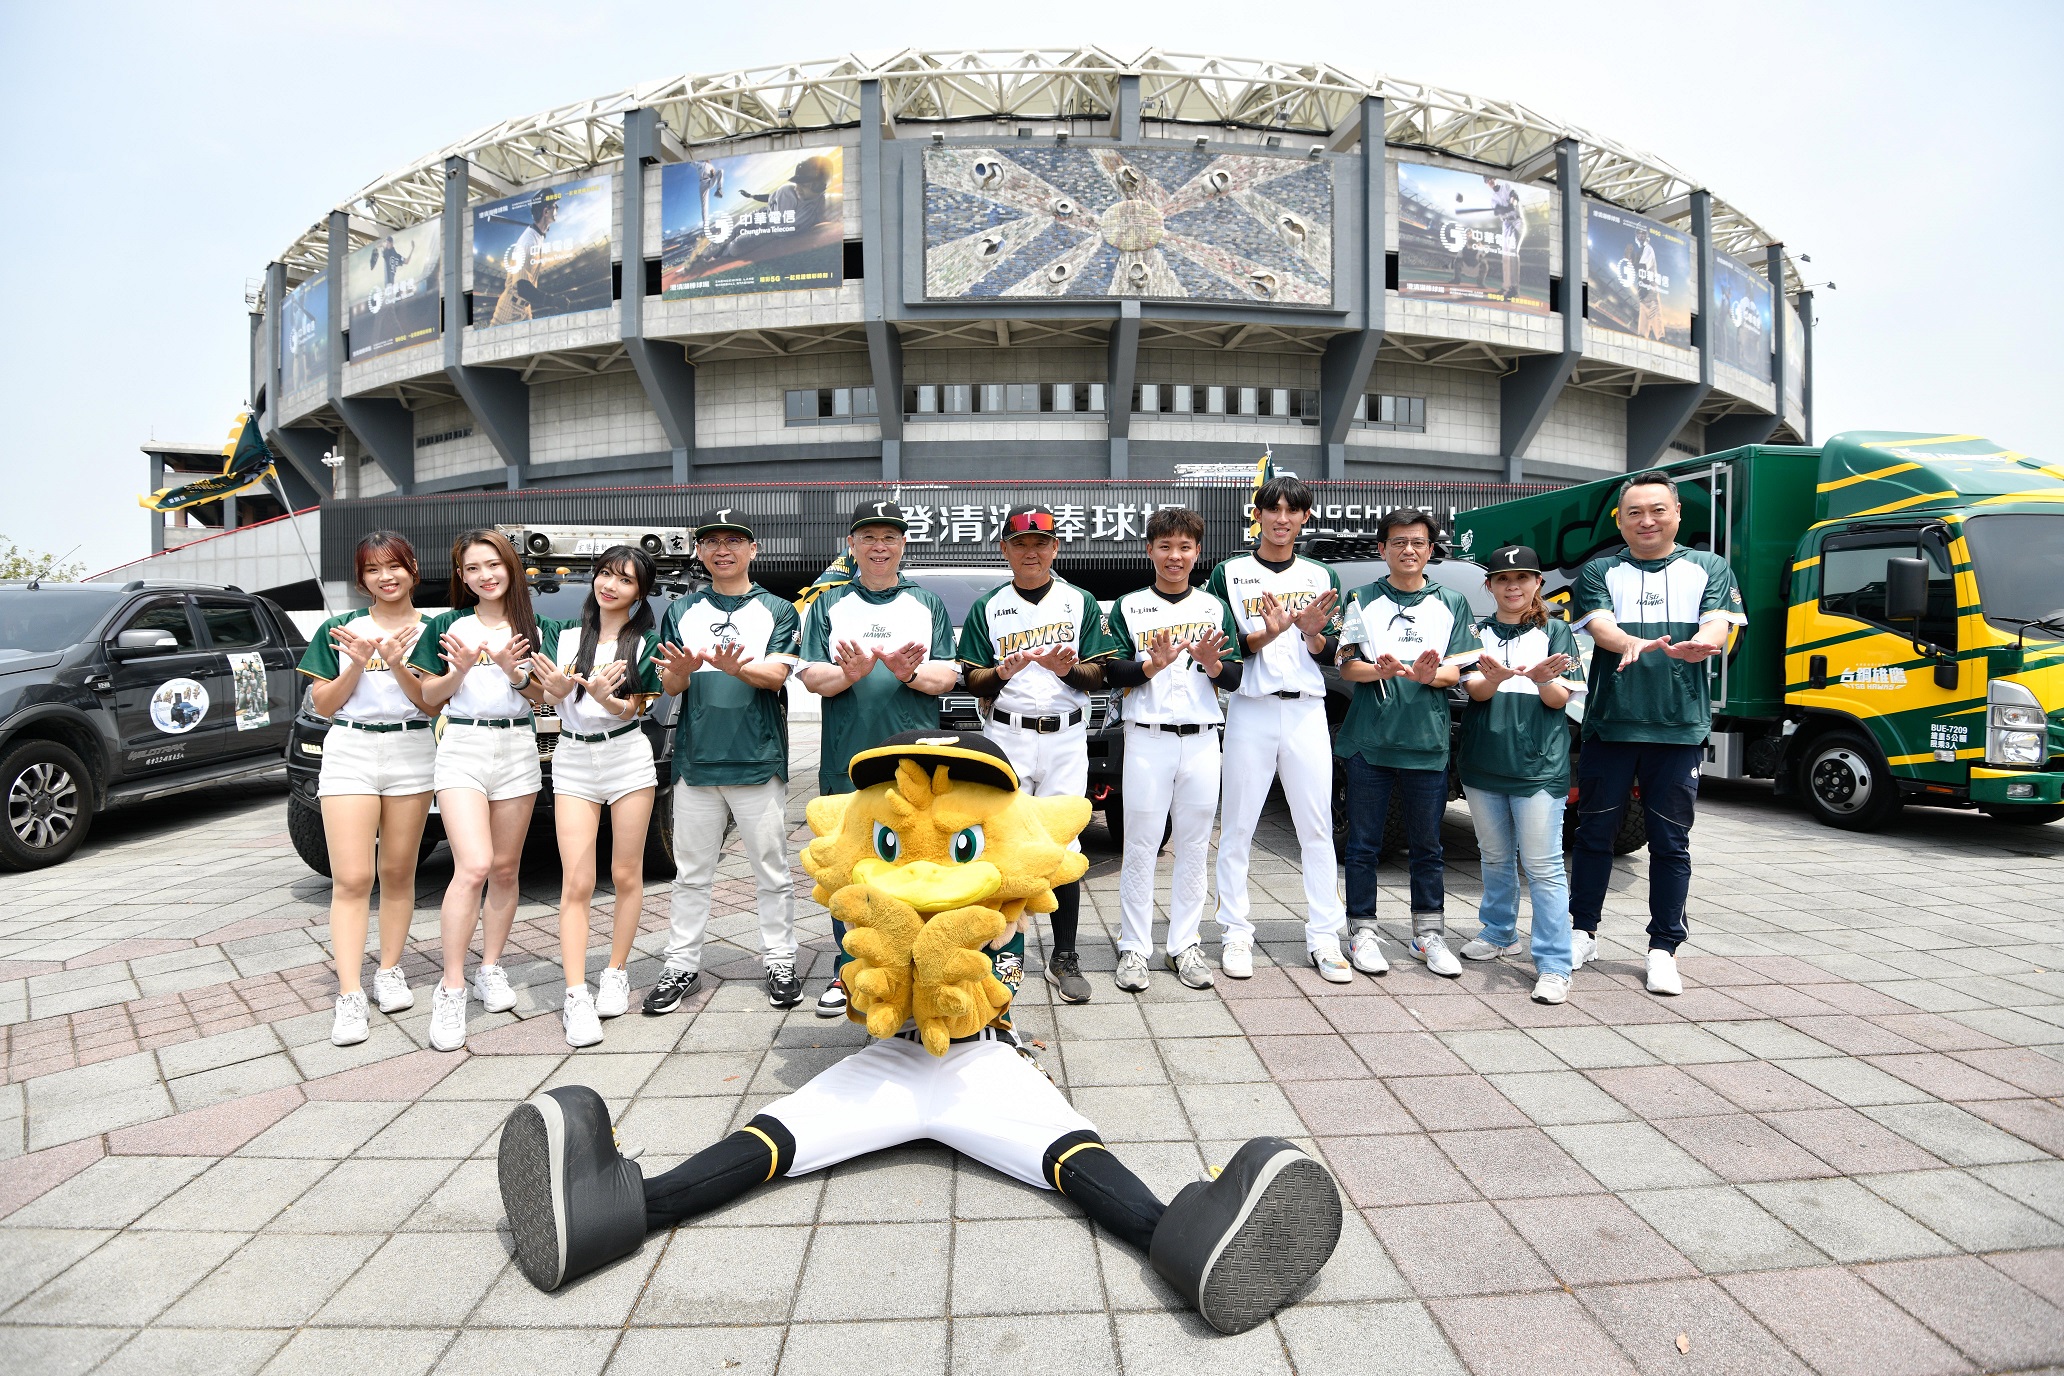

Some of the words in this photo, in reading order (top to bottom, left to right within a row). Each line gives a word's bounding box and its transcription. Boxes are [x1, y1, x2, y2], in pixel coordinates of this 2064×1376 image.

[740, 210, 796, 226] 中華電信
[740, 228, 770, 236] Chunghwa
[901, 503, 1186, 543] 澄清棒球
[671, 536, 684, 551] 玄
[1233, 577, 1260, 585] D-Link
[871, 624, 886, 632] TSG
[997, 622, 1075, 658] HAWKS
[1840, 667, 1908, 683] 台鋼雄鷹
[1867, 683, 1895, 691] HAWKS
[1931, 723, 1968, 735] BUE-7209
[127, 742, 187, 761] WILDTRAK
